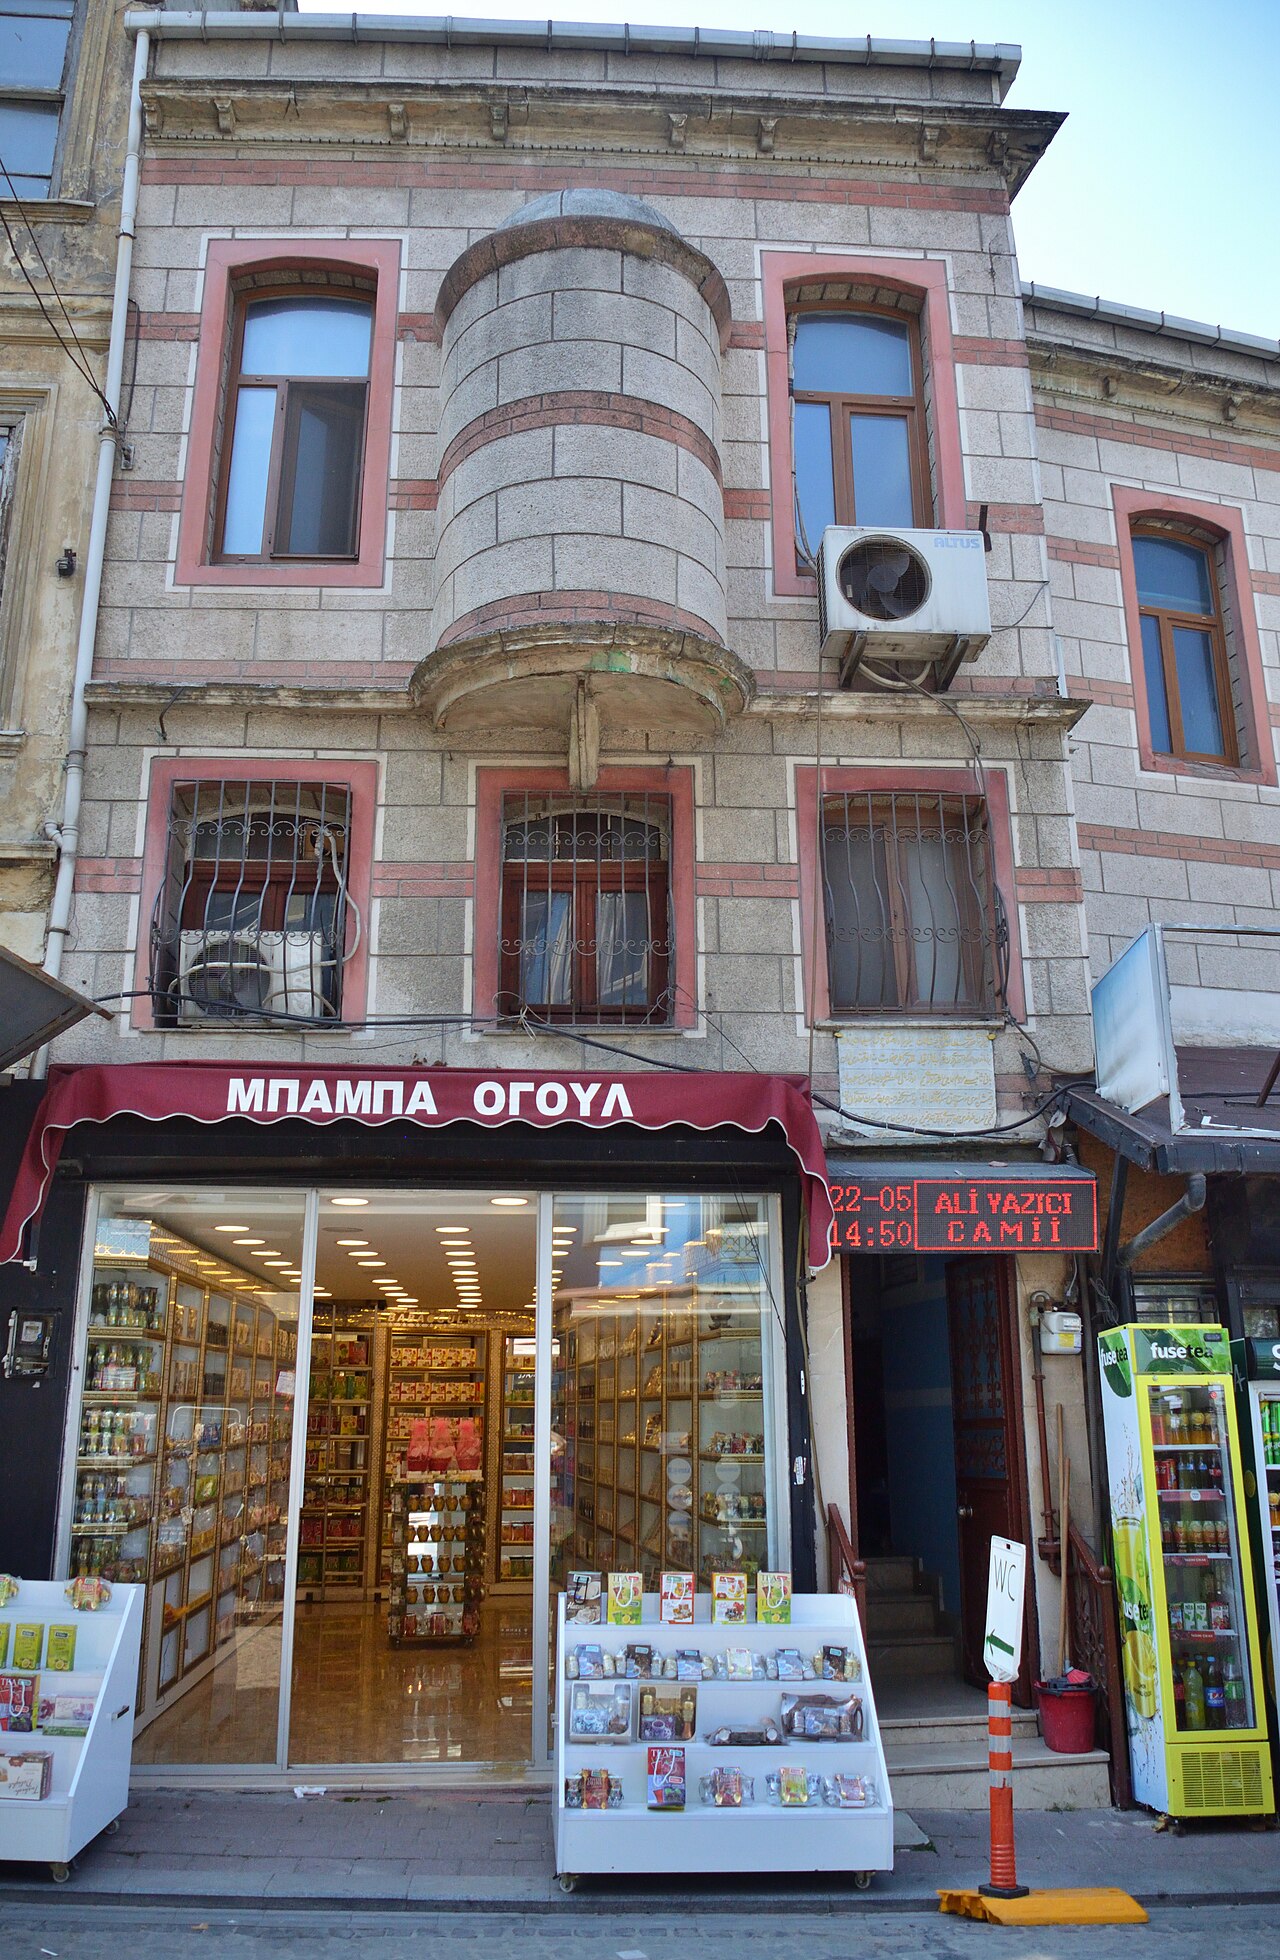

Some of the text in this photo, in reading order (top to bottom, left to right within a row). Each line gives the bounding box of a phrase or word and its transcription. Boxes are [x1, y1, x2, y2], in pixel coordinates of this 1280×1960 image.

[934, 537, 980, 549] ALTUS
[227, 1078, 633, 1117] ΜΠΑΜΠΑ ΟΓΟΥΛ
[829, 1186, 911, 1212] 22-05
[935, 1188, 1072, 1214] ALİ YAZICI
[829, 1220, 912, 1246] 14:50
[994, 1554, 1017, 1602] WC
